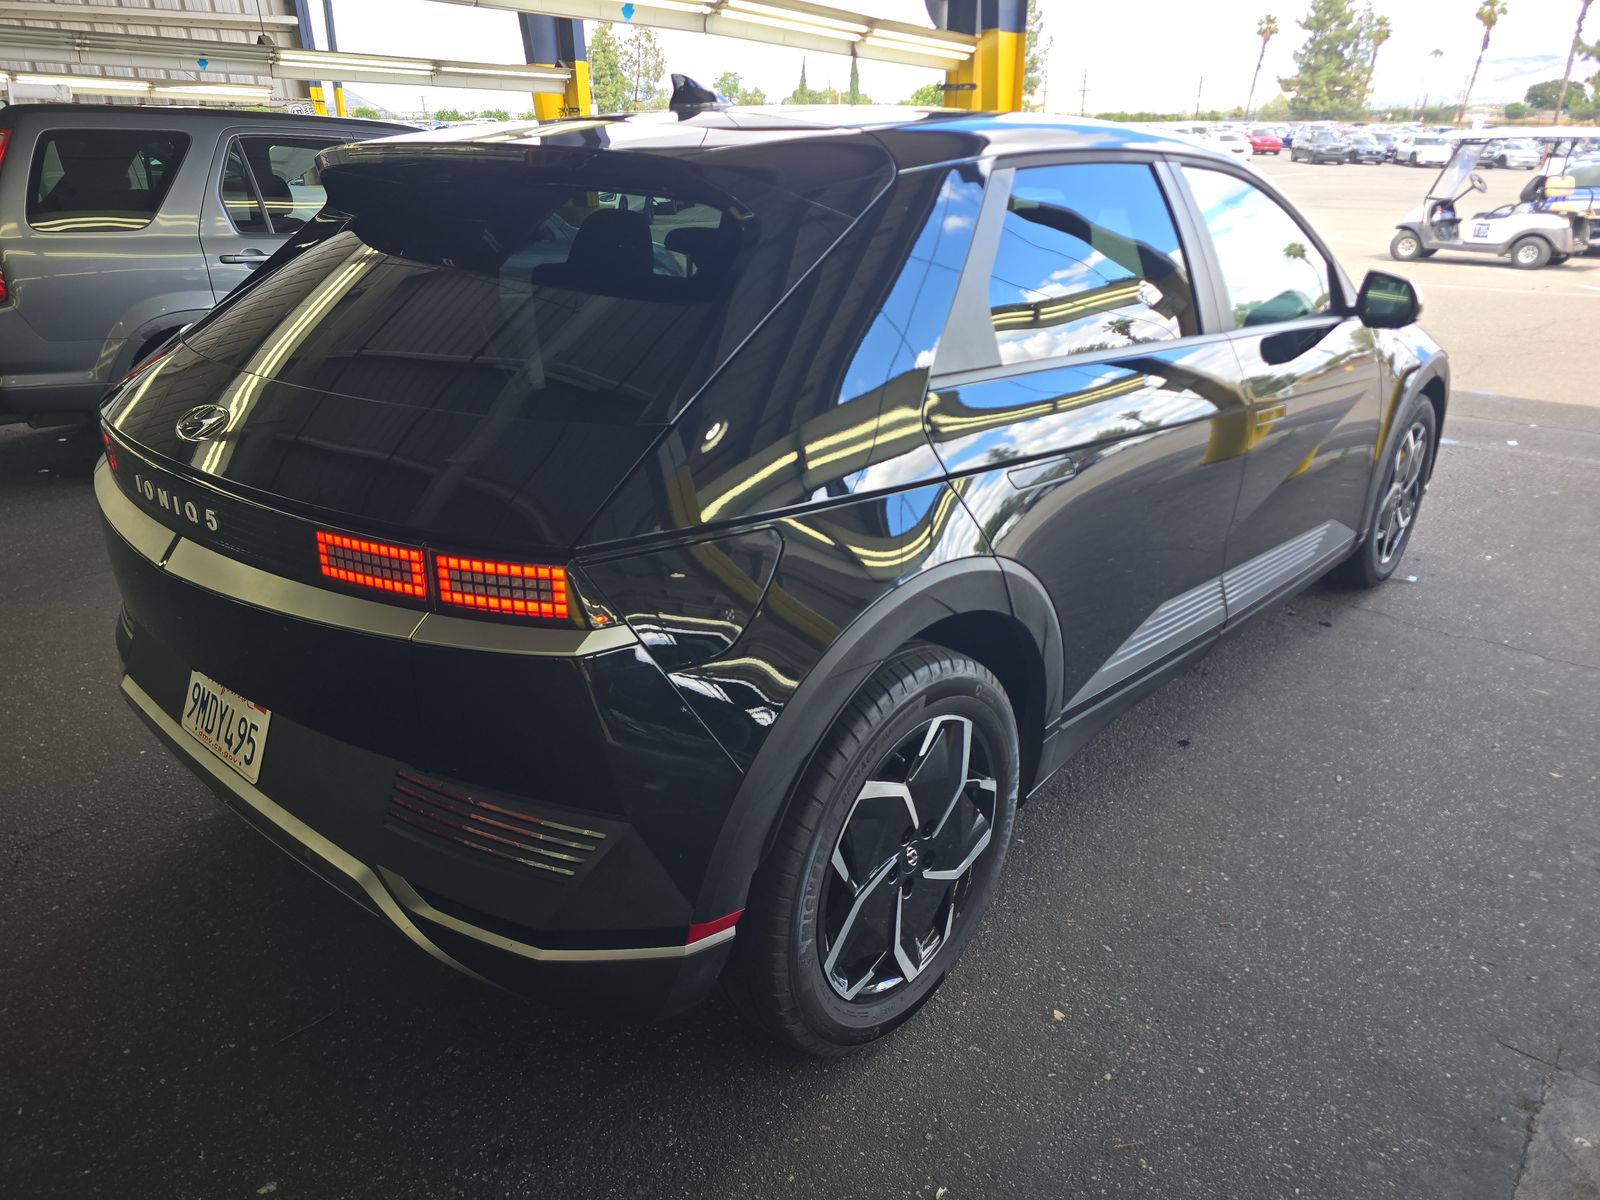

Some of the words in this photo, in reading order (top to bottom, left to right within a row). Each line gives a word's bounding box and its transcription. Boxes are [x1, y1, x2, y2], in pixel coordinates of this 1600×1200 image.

[135, 474, 199, 524] IONIQ
[205, 508, 218, 532] 5
[187, 682, 259, 766] 9MDY495
[198, 730, 238, 764] dmv.ca.gov
